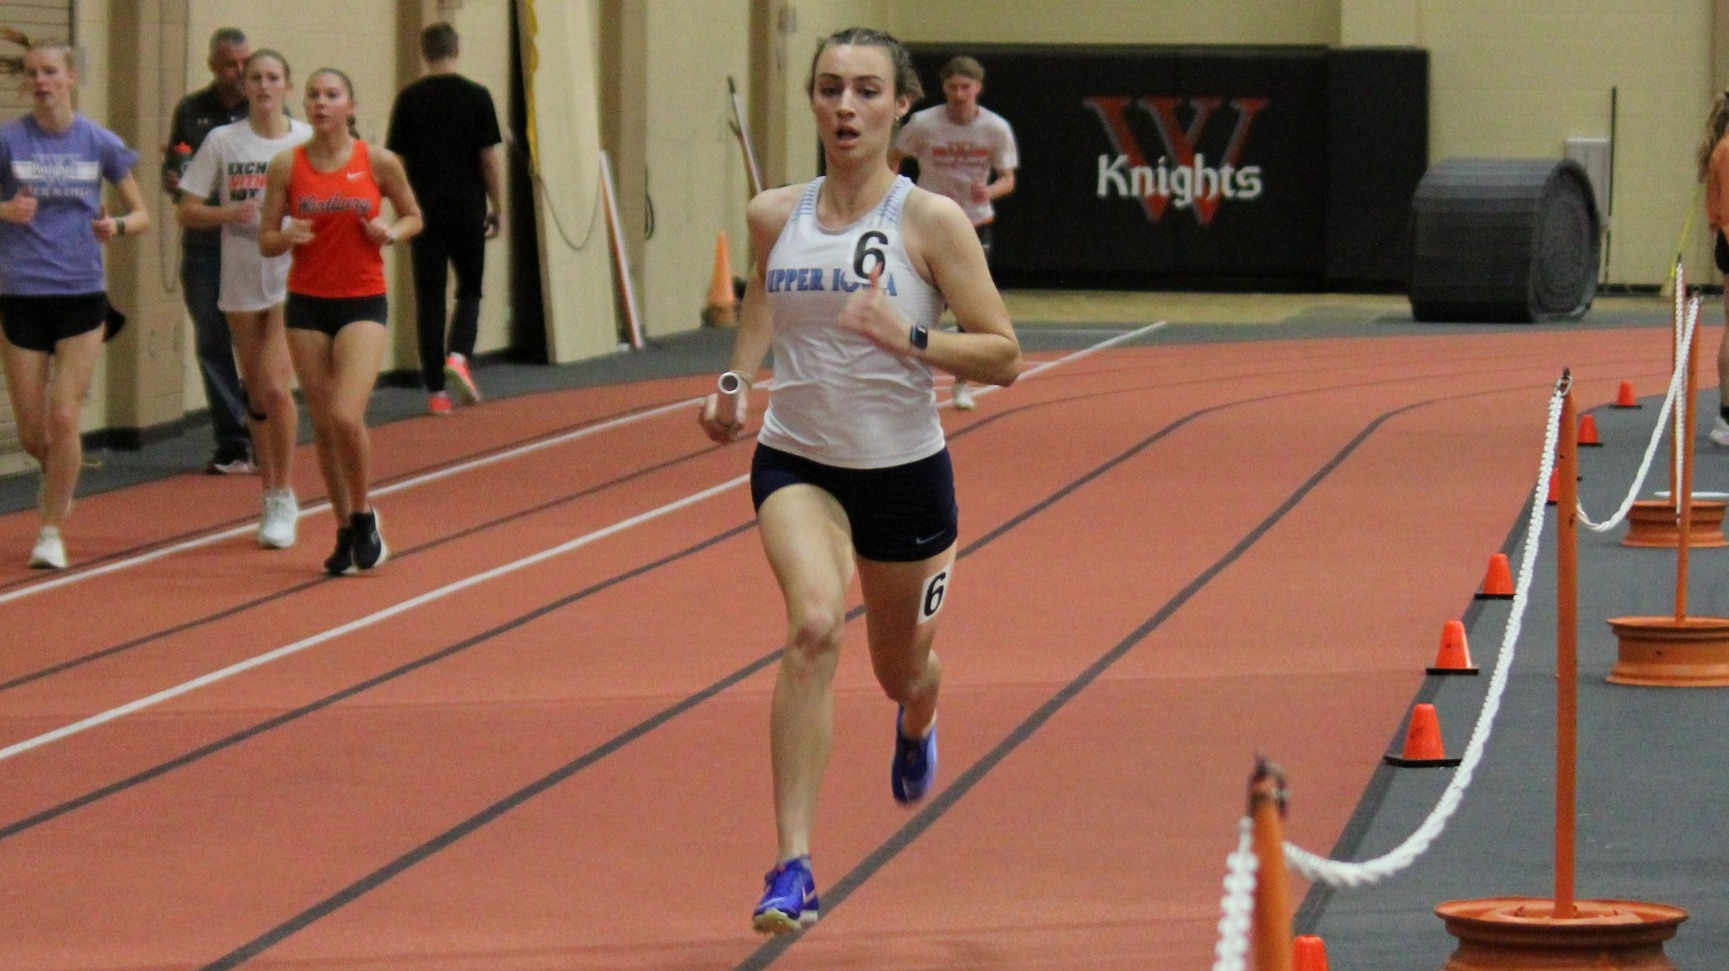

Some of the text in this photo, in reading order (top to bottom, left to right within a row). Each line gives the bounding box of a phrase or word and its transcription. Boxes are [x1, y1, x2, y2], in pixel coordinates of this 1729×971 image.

[1083, 96, 1268, 225] W
[1097, 153, 1263, 208] Knights
[853, 230, 889, 280] 6
[923, 571, 947, 617] 6
